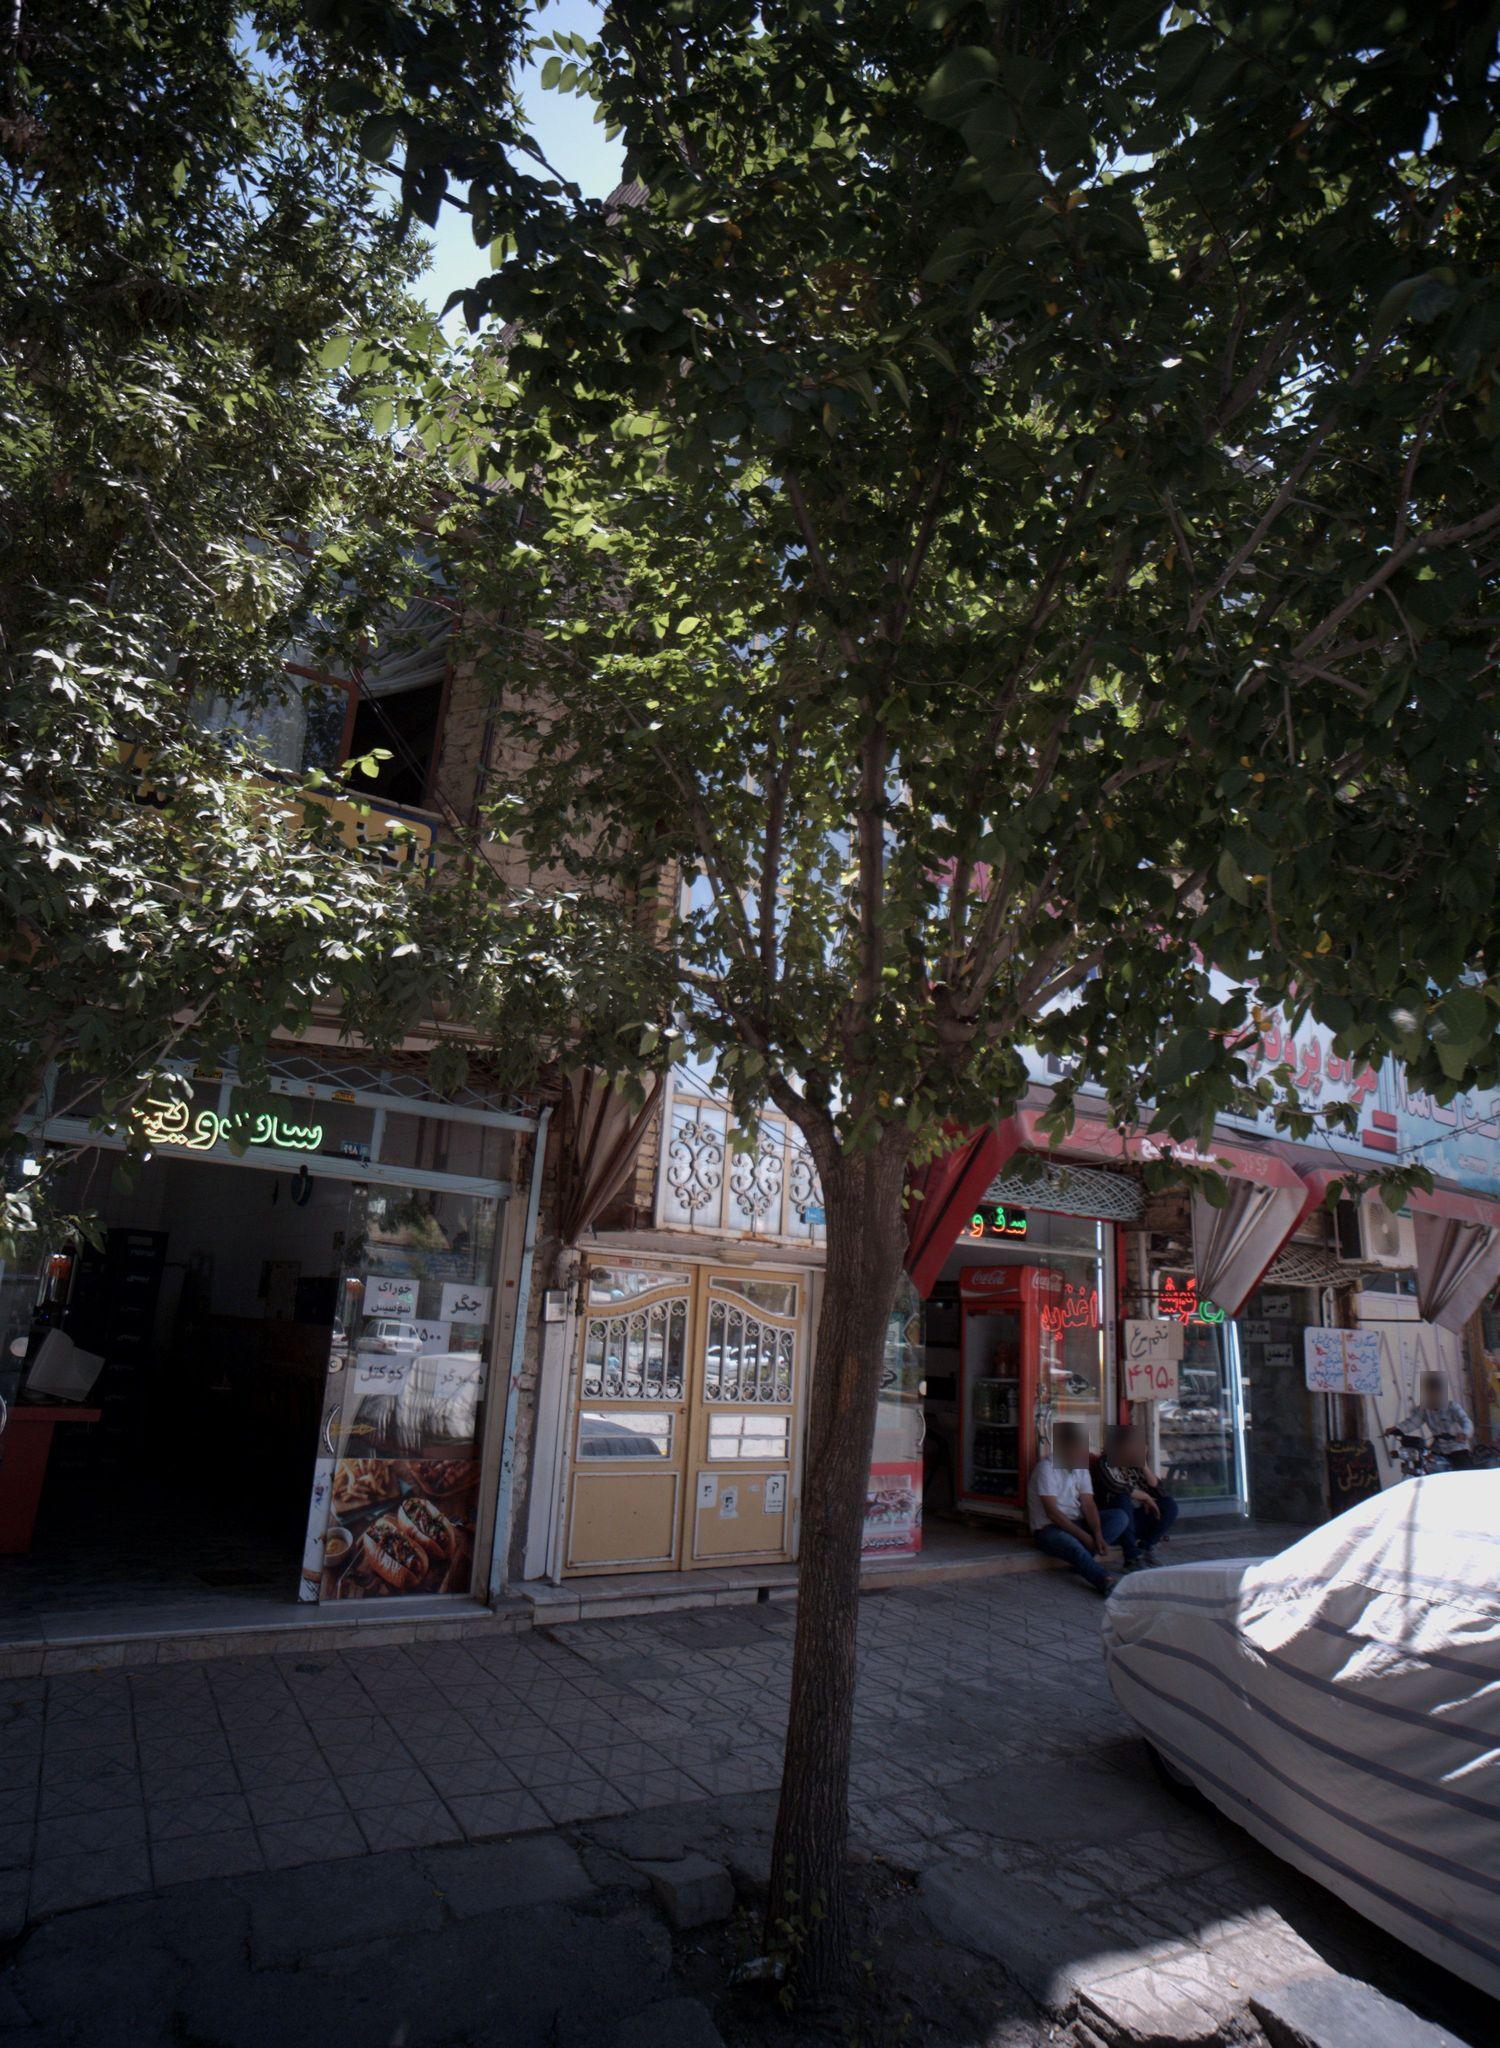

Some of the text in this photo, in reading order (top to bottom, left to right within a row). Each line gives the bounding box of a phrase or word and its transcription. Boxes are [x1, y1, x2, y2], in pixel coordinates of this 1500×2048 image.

[1141, 1138, 1217, 1163] ساندیچ
[371, 1303, 411, 1315] سوسیس
[450, 1294, 482, 1316] جگر
[1041, 1283, 1099, 1341] اغذیه
[1158, 1276, 1198, 1327] گوش
[361, 1365, 405, 1382] کوکتل
[1128, 1364, 1175, 1392] ۴۹۵۰
